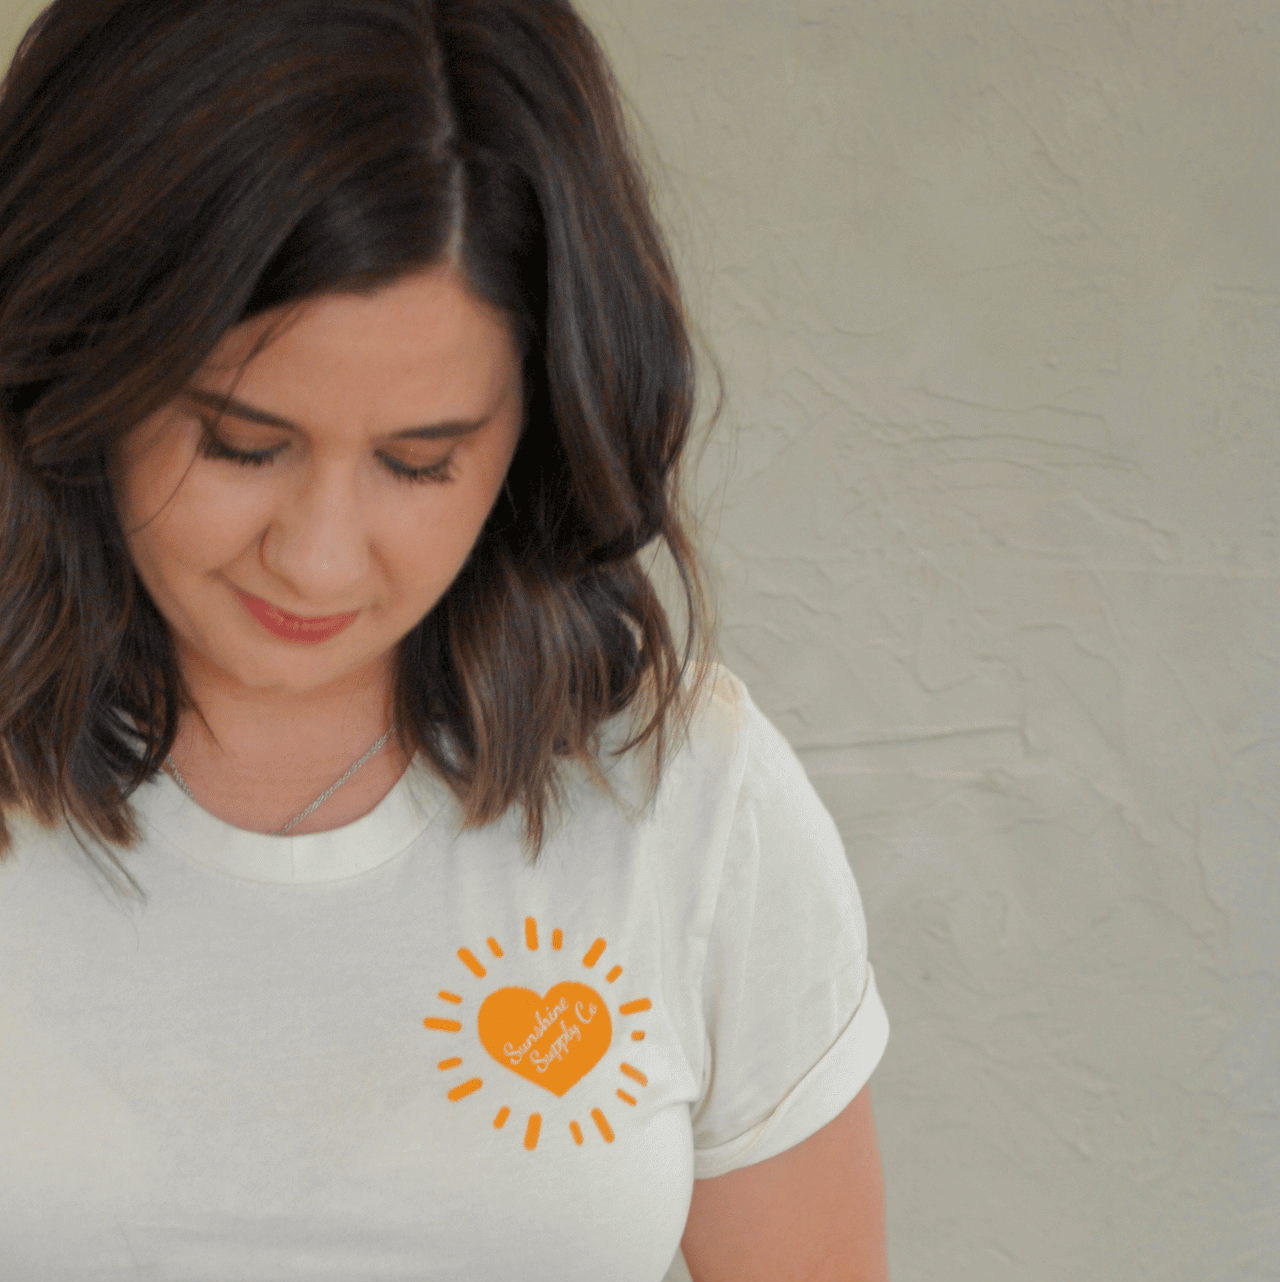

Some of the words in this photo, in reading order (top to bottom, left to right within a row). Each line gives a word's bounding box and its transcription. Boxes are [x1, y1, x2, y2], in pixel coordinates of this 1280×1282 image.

[503, 996, 570, 1066] Sunshine
[529, 1019, 582, 1073] Supply
[574, 1000, 598, 1025] Co
